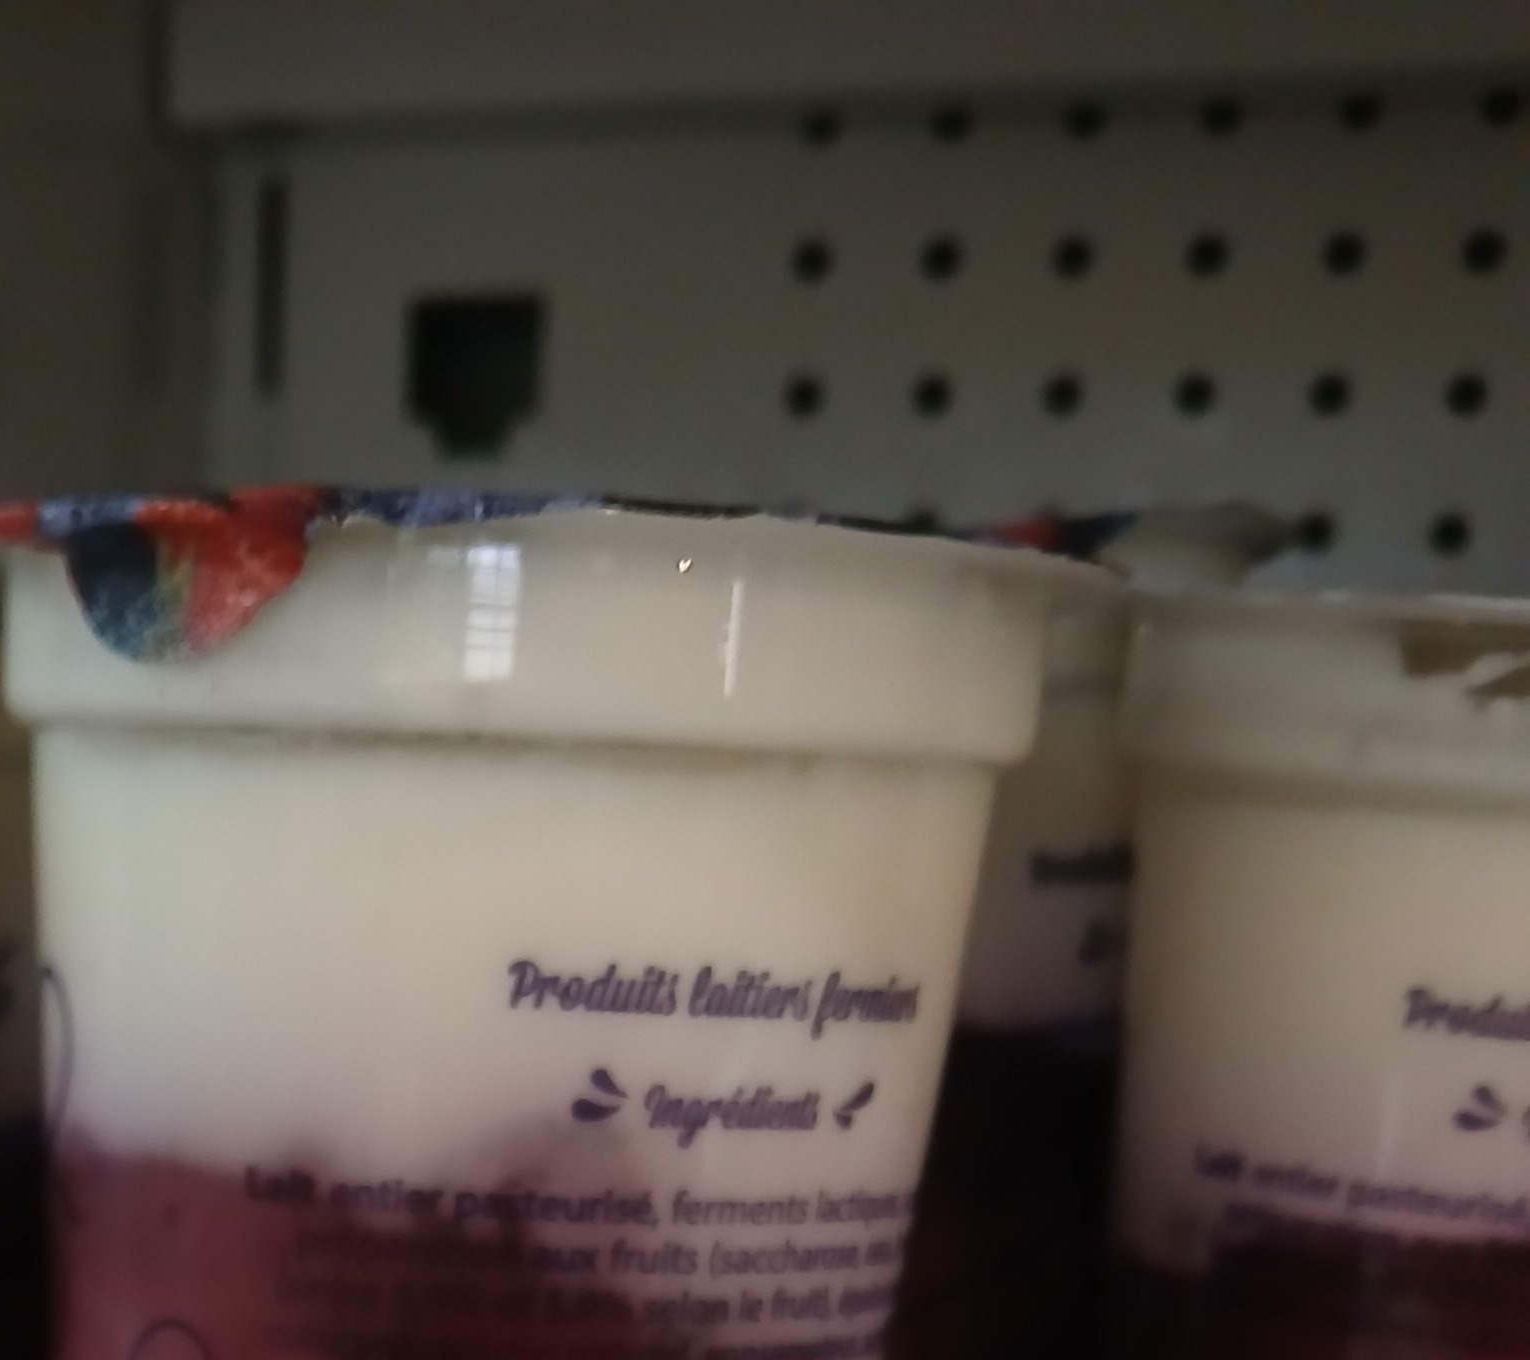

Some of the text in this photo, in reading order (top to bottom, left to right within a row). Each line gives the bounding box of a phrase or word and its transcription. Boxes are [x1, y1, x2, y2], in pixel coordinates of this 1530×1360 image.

[508, 959, 679, 1017] Produits
[328, 1180, 445, 1216] entier
[670, 1189, 808, 1228] ferments
[609, 1239, 698, 1277] fruits
